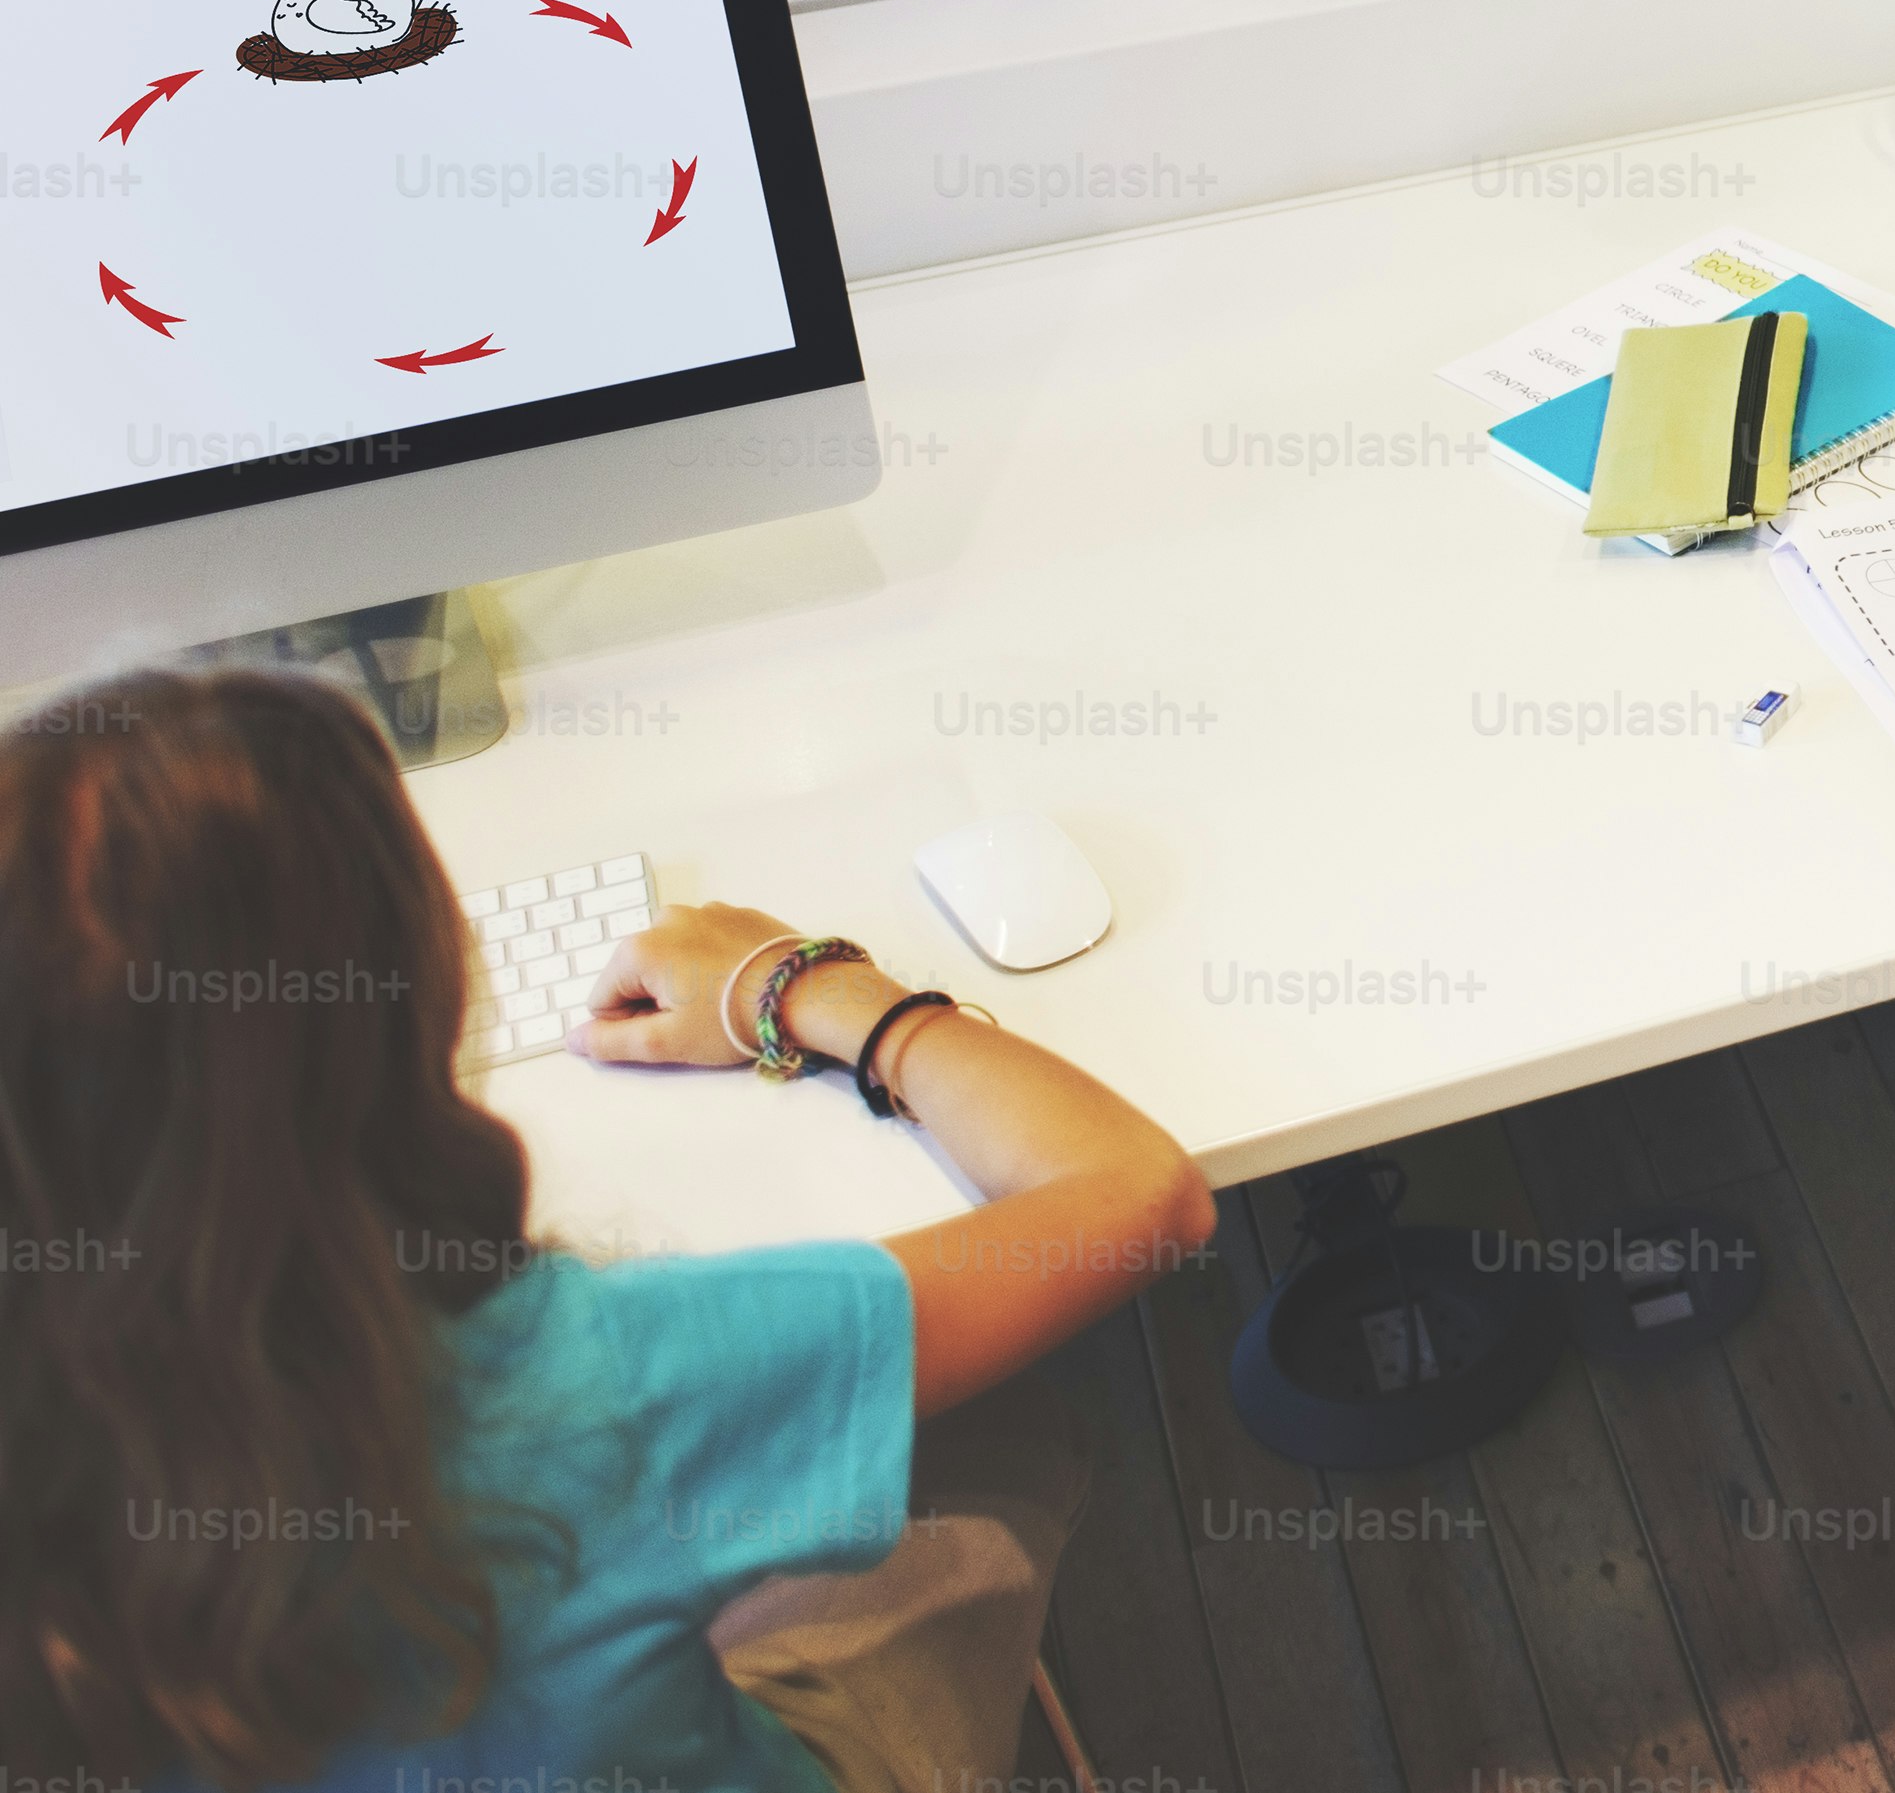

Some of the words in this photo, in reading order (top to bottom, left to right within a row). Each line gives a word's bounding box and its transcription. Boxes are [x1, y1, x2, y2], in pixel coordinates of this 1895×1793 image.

[1703, 259, 1730, 275] DO
[1732, 270, 1769, 290] YOU
[1655, 283, 1706, 309] CIRCLE
[1572, 325, 1608, 347] OVEL
[1528, 346, 1587, 378] SQUERE
[1818, 517, 1886, 541] Lesson
